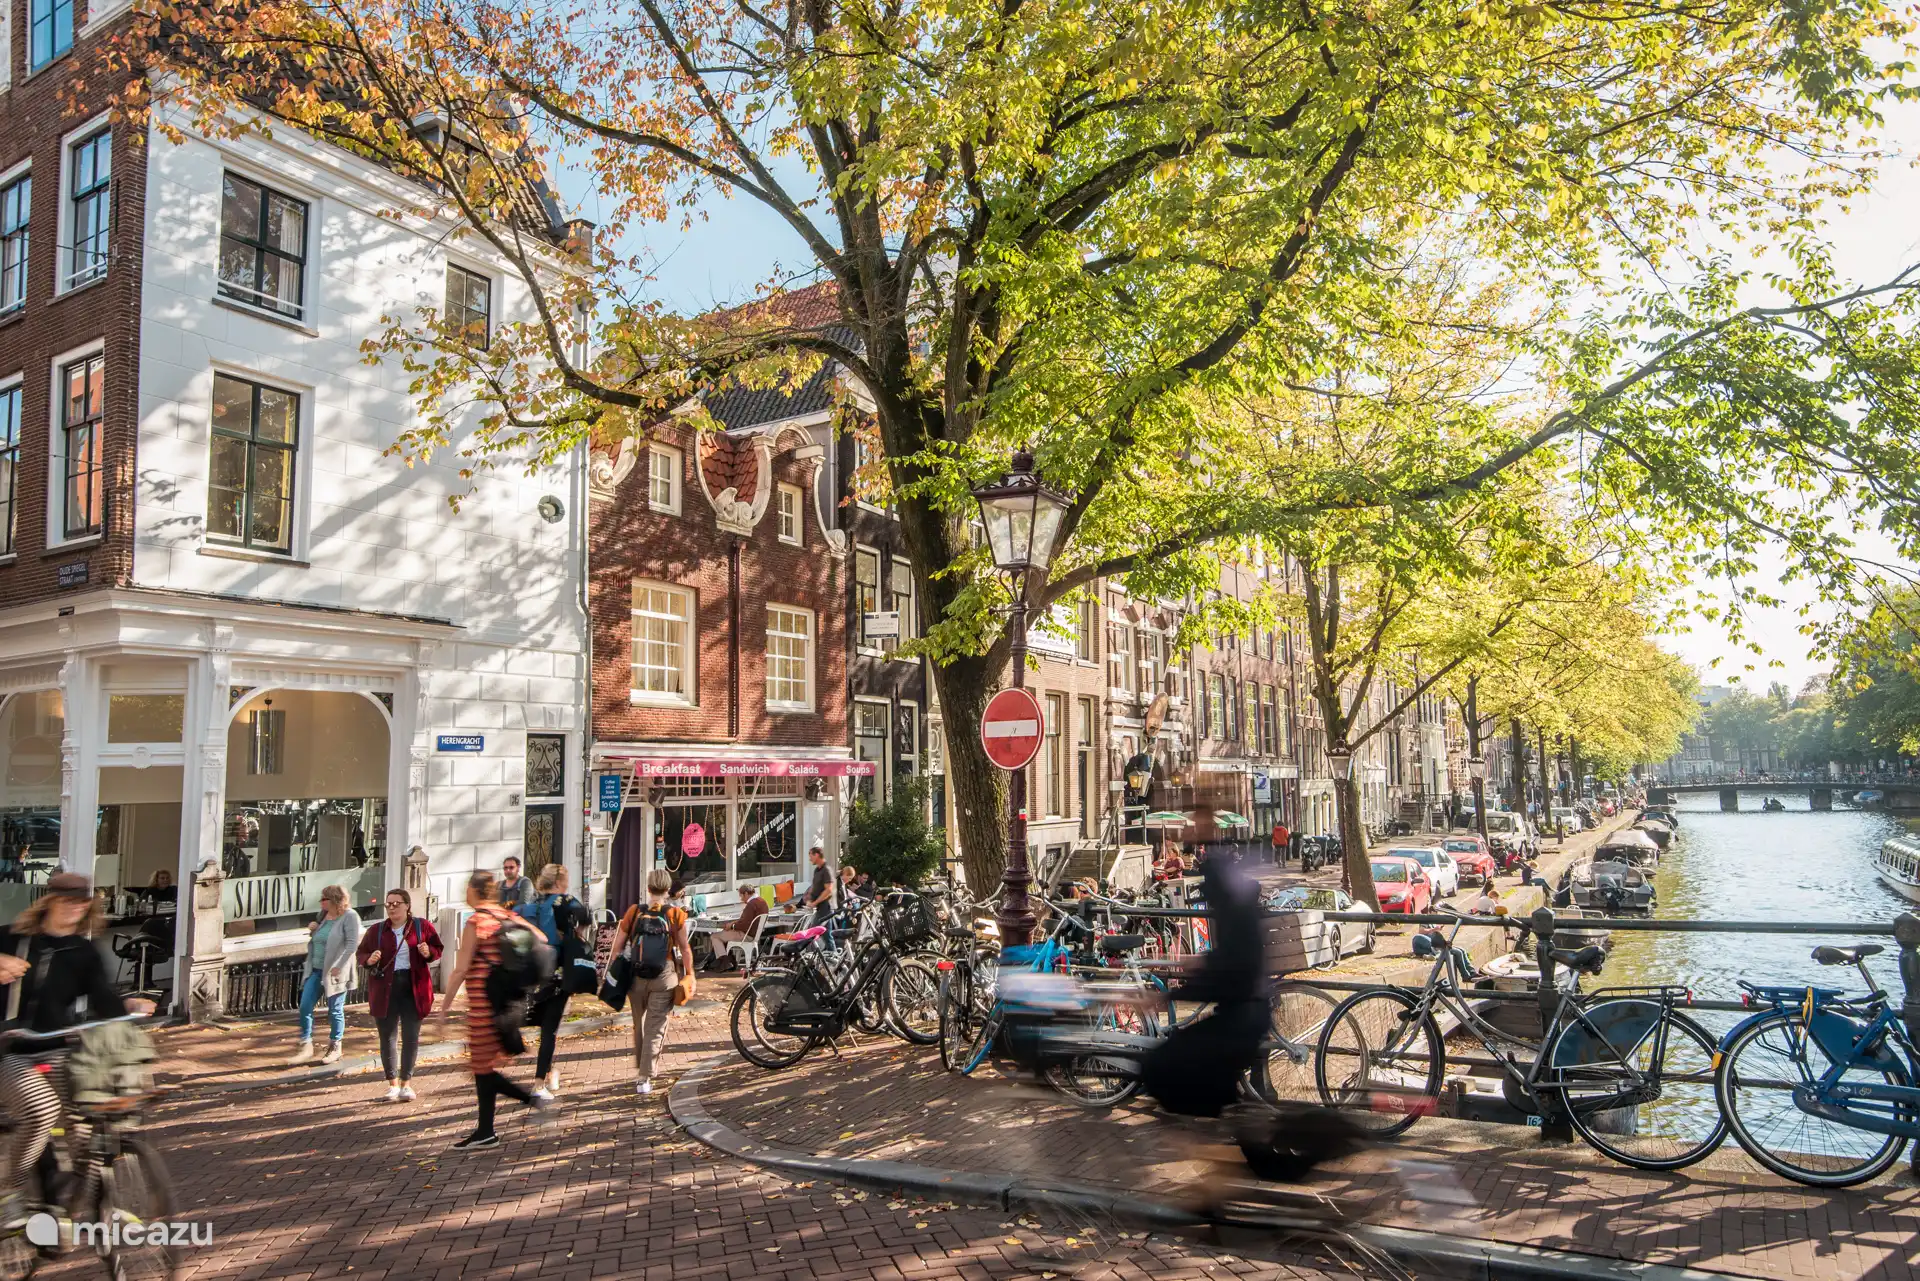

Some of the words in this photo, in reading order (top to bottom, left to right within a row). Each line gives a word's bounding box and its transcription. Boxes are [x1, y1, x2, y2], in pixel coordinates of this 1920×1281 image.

[59, 565, 71, 576] OUDE
[59, 575, 74, 585] STRAAT
[441, 736, 481, 745] HERENGRACHT
[642, 763, 701, 774] Breakfast
[720, 764, 770, 774] Sandwich
[788, 764, 819, 774] Salads
[846, 765, 871, 775] Soups
[601, 800, 608, 808] To
[608, 800, 619, 808] Go
[737, 840, 750, 857] BEST
[750, 829, 763, 846] SOUP
[763, 823, 770, 835] IN
[769, 811, 784, 829] TOWN
[233, 875, 306, 919] SIMONE
